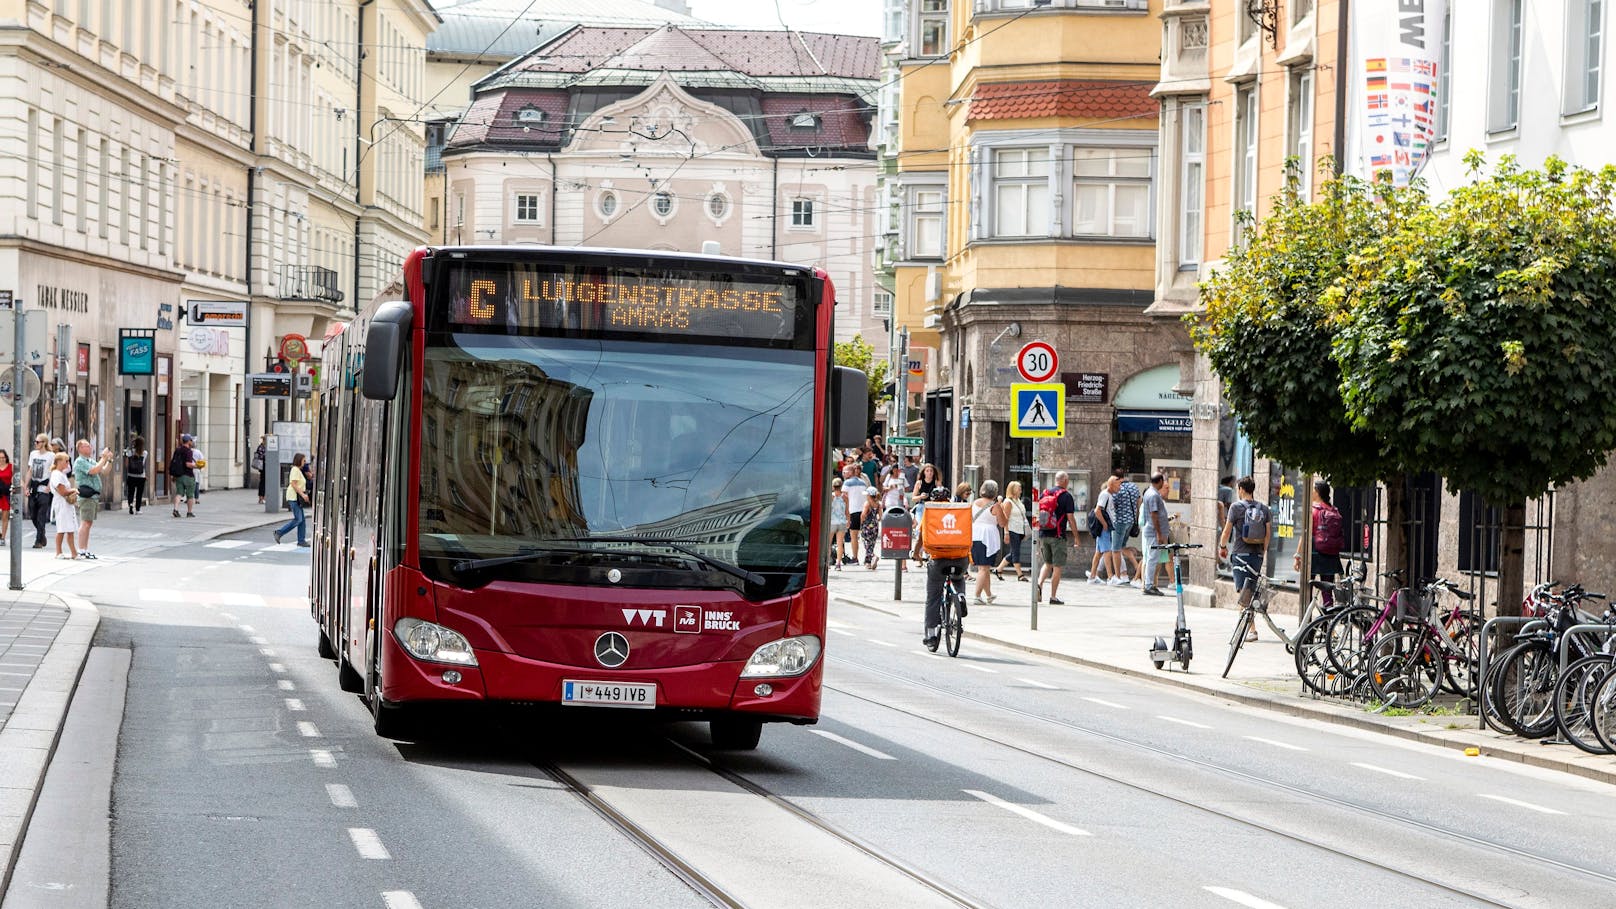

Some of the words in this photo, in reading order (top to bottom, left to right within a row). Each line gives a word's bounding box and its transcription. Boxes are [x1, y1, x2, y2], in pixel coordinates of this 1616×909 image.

[37, 283, 58, 309] TABAK
[469, 279, 495, 319] C
[522, 279, 783, 313] LUIGENSTRASSE
[611, 306, 690, 328] AMRAS
[130, 345, 149, 356] FASS
[1028, 353, 1048, 372] 30
[1082, 373, 1105, 382] Herzog-
[1082, 388, 1103, 396] Straße
[1159, 418, 1184, 426] NÄGELE
[1278, 498, 1295, 525] SALE
[679, 617, 696, 625] IVB
[704, 620, 741, 631] BRUCK
[594, 686, 621, 701] 449
[623, 688, 647, 702] IVB
